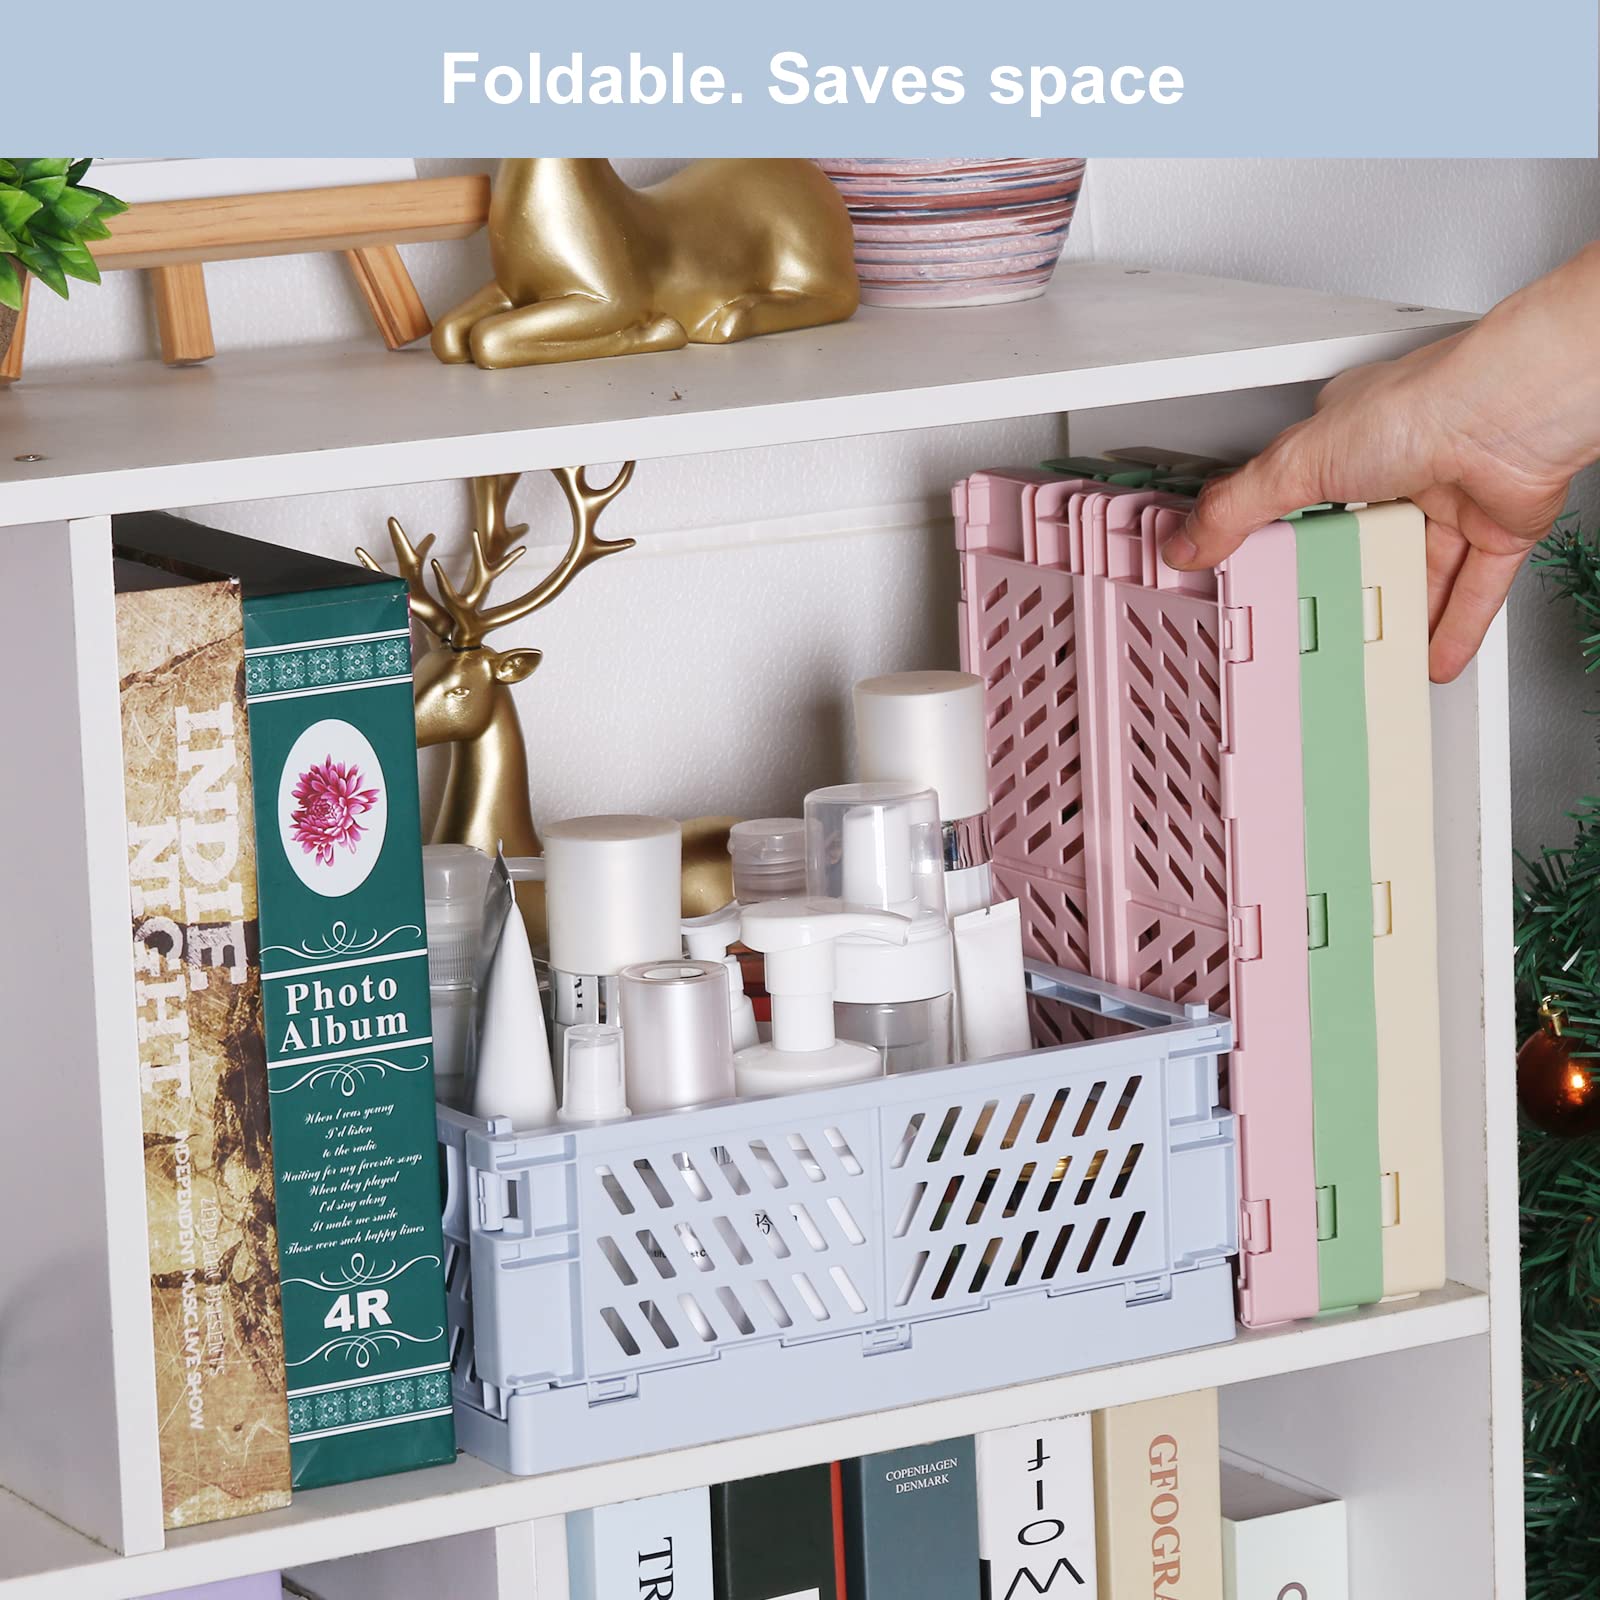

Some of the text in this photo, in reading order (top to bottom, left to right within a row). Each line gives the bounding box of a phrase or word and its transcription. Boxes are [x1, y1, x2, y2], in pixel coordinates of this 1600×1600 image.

[175, 701, 247, 991] INDIE
[129, 815, 191, 1099] NIGHT
[285, 975, 397, 1015] Photo
[279, 1011, 408, 1052] Album
[304, 1103, 394, 1125] When I was young
[347, 1124, 372, 1137] listen
[323, 1140, 377, 1158] to the radio
[281, 1153, 422, 1183] Waiting for my favorite songs
[309, 1171, 399, 1196] When they played
[336, 1199, 356, 1212] sing
[359, 1194, 387, 1208] along
[310, 1208, 398, 1232] It make me smile
[285, 1223, 425, 1255] Those were such happy times
[174, 1130, 204, 1430] INDEPENDENT MUSIC LIVE SHOW
[324, 1289, 392, 1332] 4R
[886, 1458, 958, 1482] COPENHAGEN
[896, 1474, 949, 1493] DENMARK
